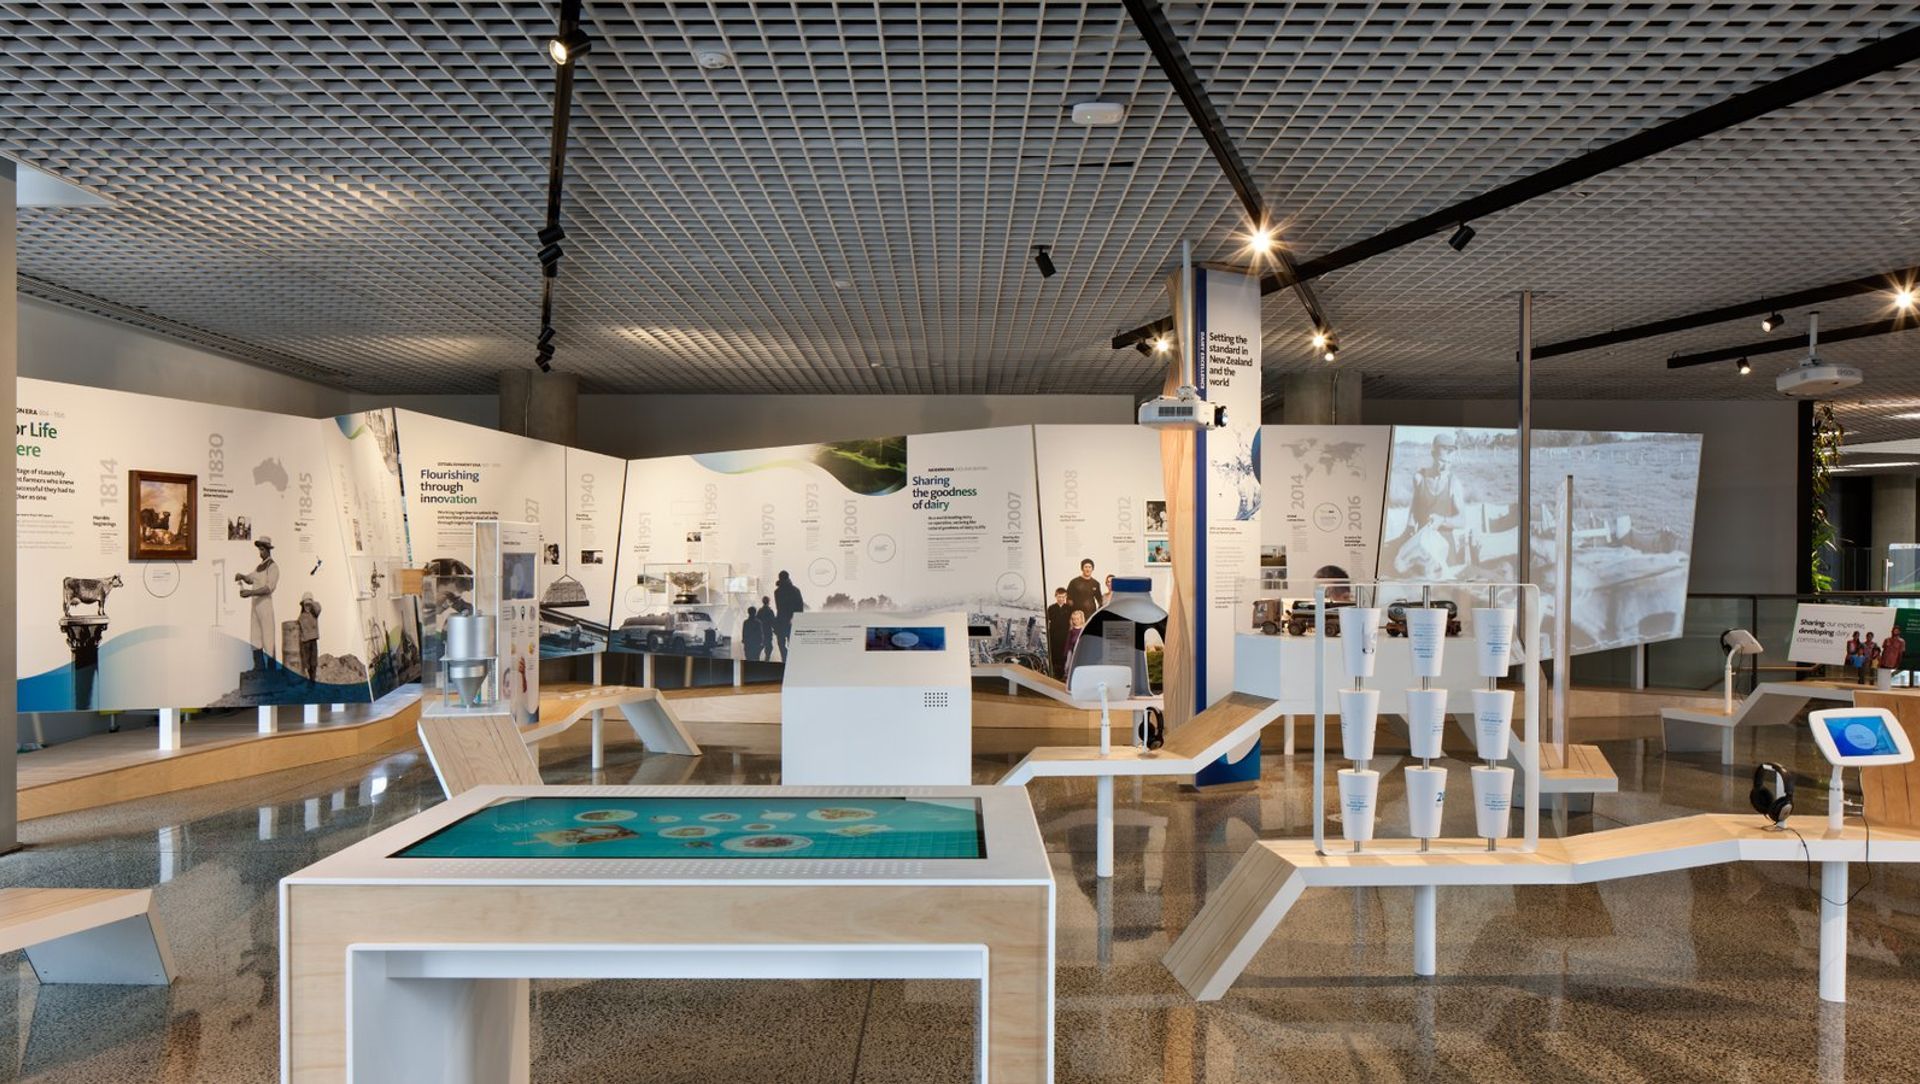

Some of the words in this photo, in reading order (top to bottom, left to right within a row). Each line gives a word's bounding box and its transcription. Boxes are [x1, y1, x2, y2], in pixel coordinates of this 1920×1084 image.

[1209, 332, 1235, 345] Setting
[1236, 335, 1248, 344] the
[1209, 345, 1240, 355] standard
[1241, 347, 1249, 355] in
[1209, 355, 1225, 364] New
[1226, 356, 1253, 367] Zealand
[1209, 367, 1222, 375] and
[1224, 367, 1236, 376] the
[1209, 378, 1230, 387] world
[30, 422, 57, 439] Life
[16, 444, 41, 457] ere
[208, 433, 224, 481] 1830
[100, 457, 118, 507] 1814
[420, 469, 480, 483] Flourishing
[912, 476, 950, 488] Sharing
[44, 486, 57, 495] they
[299, 472, 313, 516] 1845
[420, 481, 464, 494] through
[581, 473, 594, 509] 1940
[912, 488, 929, 497] the
[930, 487, 978, 500] goodness
[1064, 470, 1078, 509] 2008
[1291, 474, 1304, 509] 2014
[420, 493, 478, 504] innovation
[704, 483, 718, 516] 1969
[806, 483, 818, 514] 1973
[912, 500, 923, 510] of
[924, 499, 950, 512] dairy
[525, 498, 539, 523] 927
[844, 500, 858, 535] 2001
[1008, 491, 1021, 529] 2007
[1118, 496, 1132, 531] 2012
[1347, 496, 1362, 531] 2016
[639, 512, 651, 540] 1951
[762, 503, 775, 537] 1970
[1800, 619, 1825, 628] Sharing
[1798, 627, 1835, 637] developing
[1835, 629, 1850, 639] dairy
[1796, 637, 1834, 645] communities
